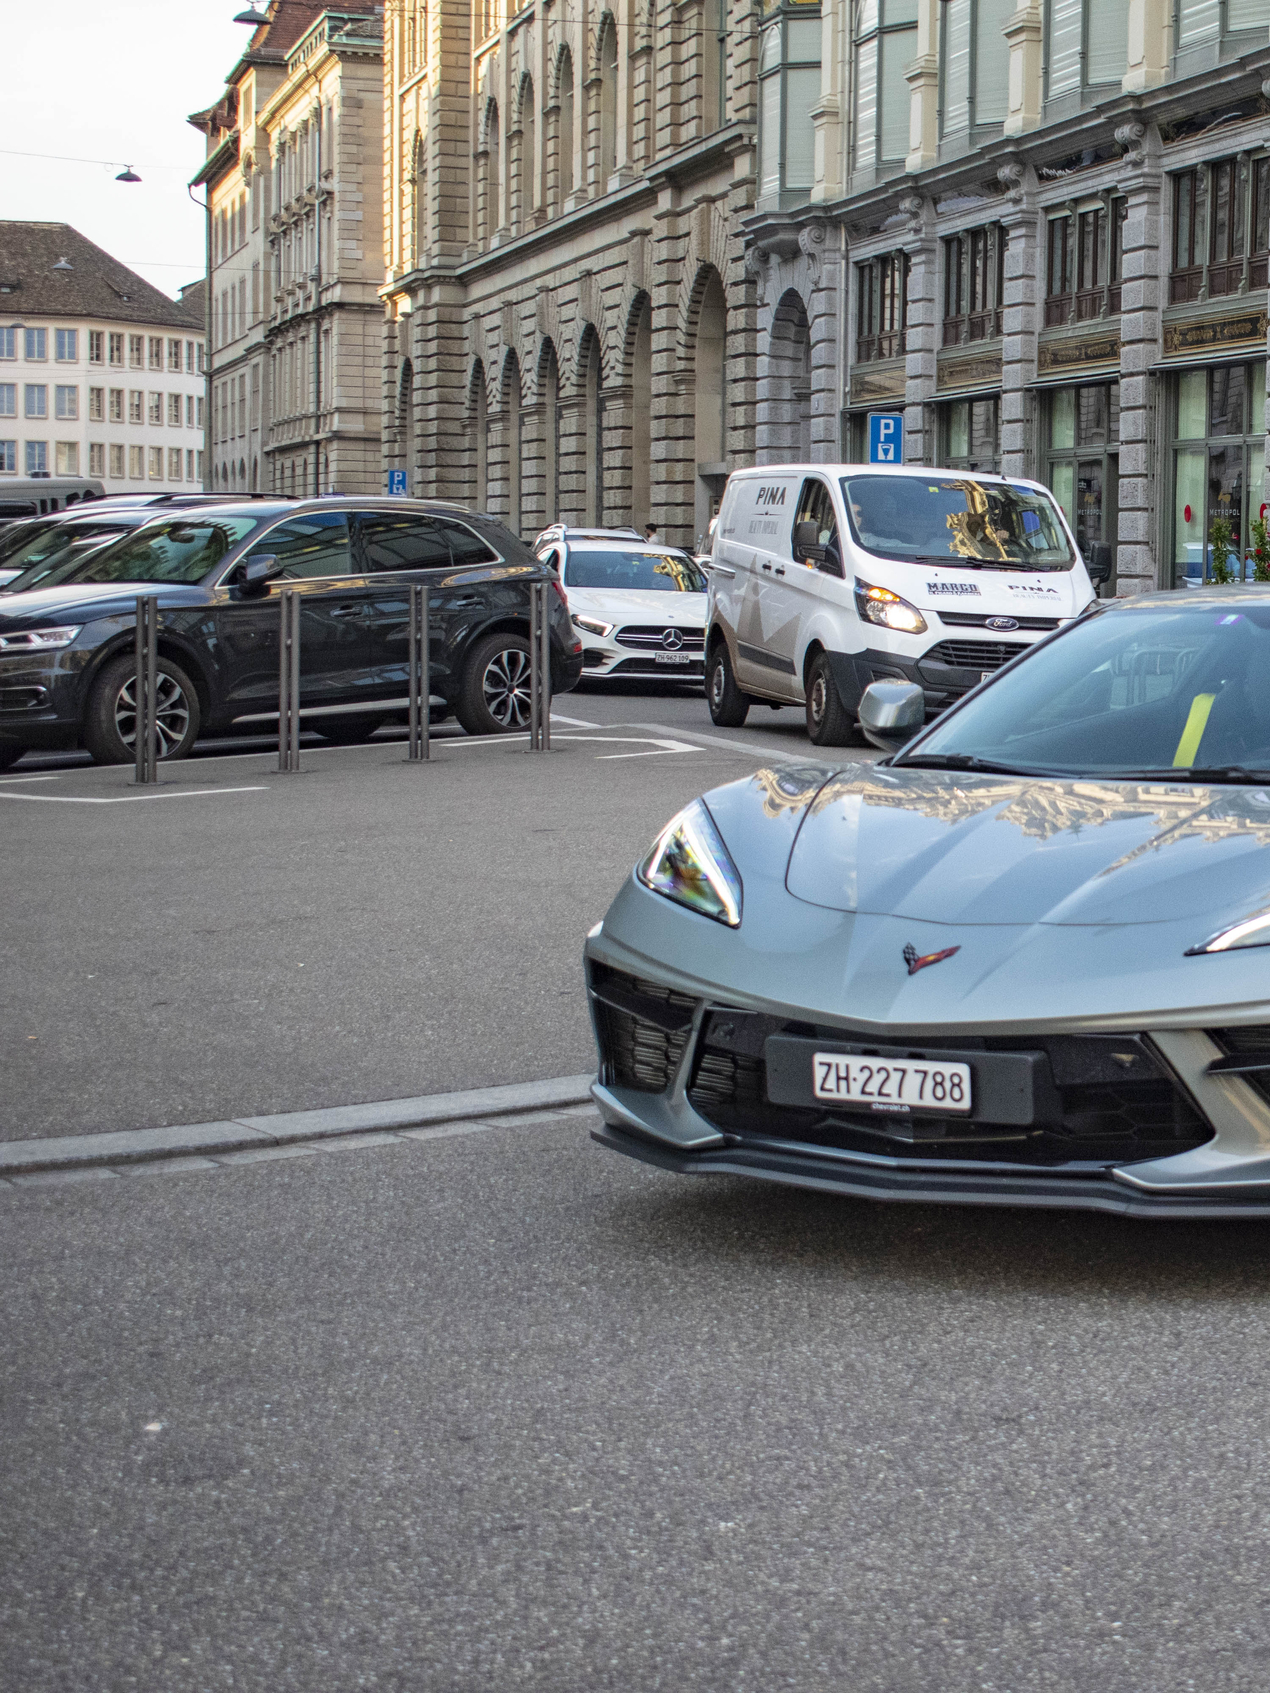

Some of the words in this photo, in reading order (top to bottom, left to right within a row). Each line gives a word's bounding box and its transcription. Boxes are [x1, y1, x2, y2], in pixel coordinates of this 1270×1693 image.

[880, 418, 894, 442] P
[394, 472, 403, 484] P
[755, 486, 787, 505] PINA
[1209, 508, 1240, 516] METROPOL
[1007, 585, 1059, 594] PINA
[993, 618, 1013, 627] Ford
